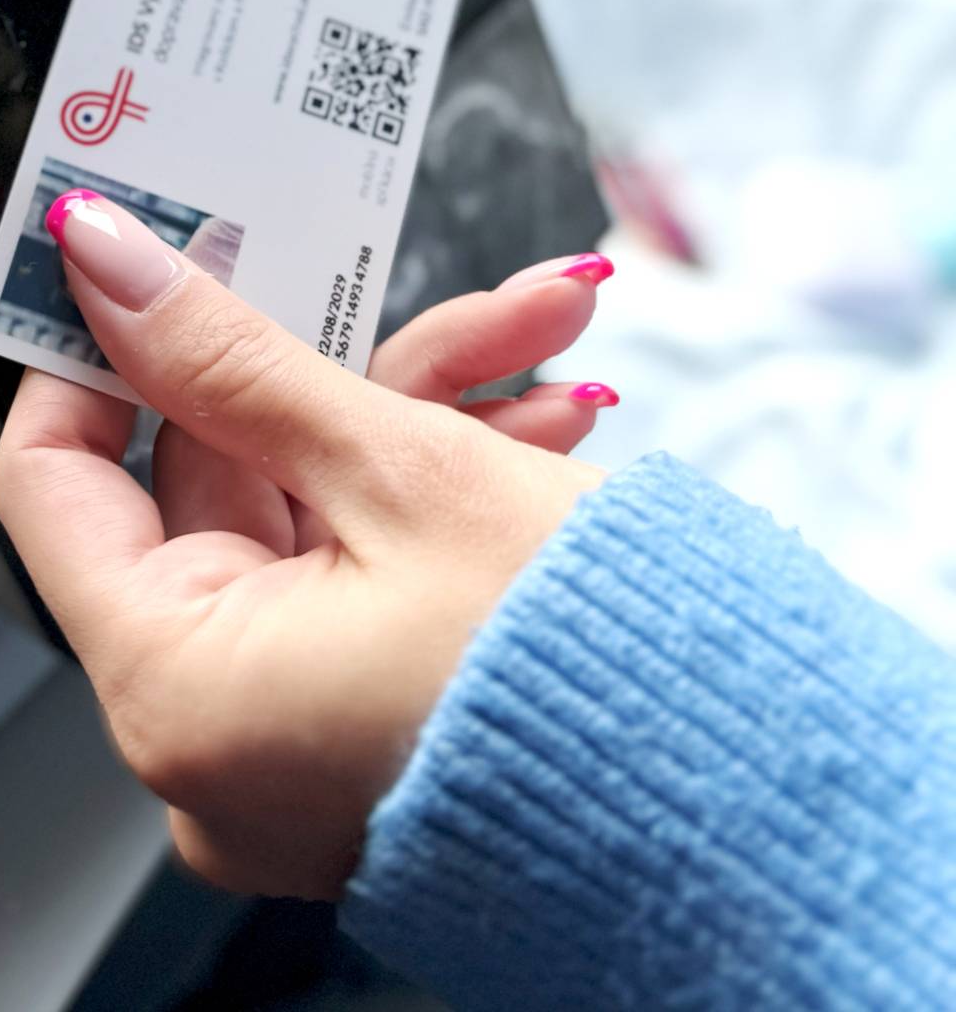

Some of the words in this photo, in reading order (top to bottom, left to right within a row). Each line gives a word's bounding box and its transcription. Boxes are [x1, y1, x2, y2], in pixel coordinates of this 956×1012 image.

[126, 21, 150, 55] IDS
[354, 244, 373, 282] 4788
[344, 282, 364, 320] 1493
[335, 321, 354, 361] 5679
